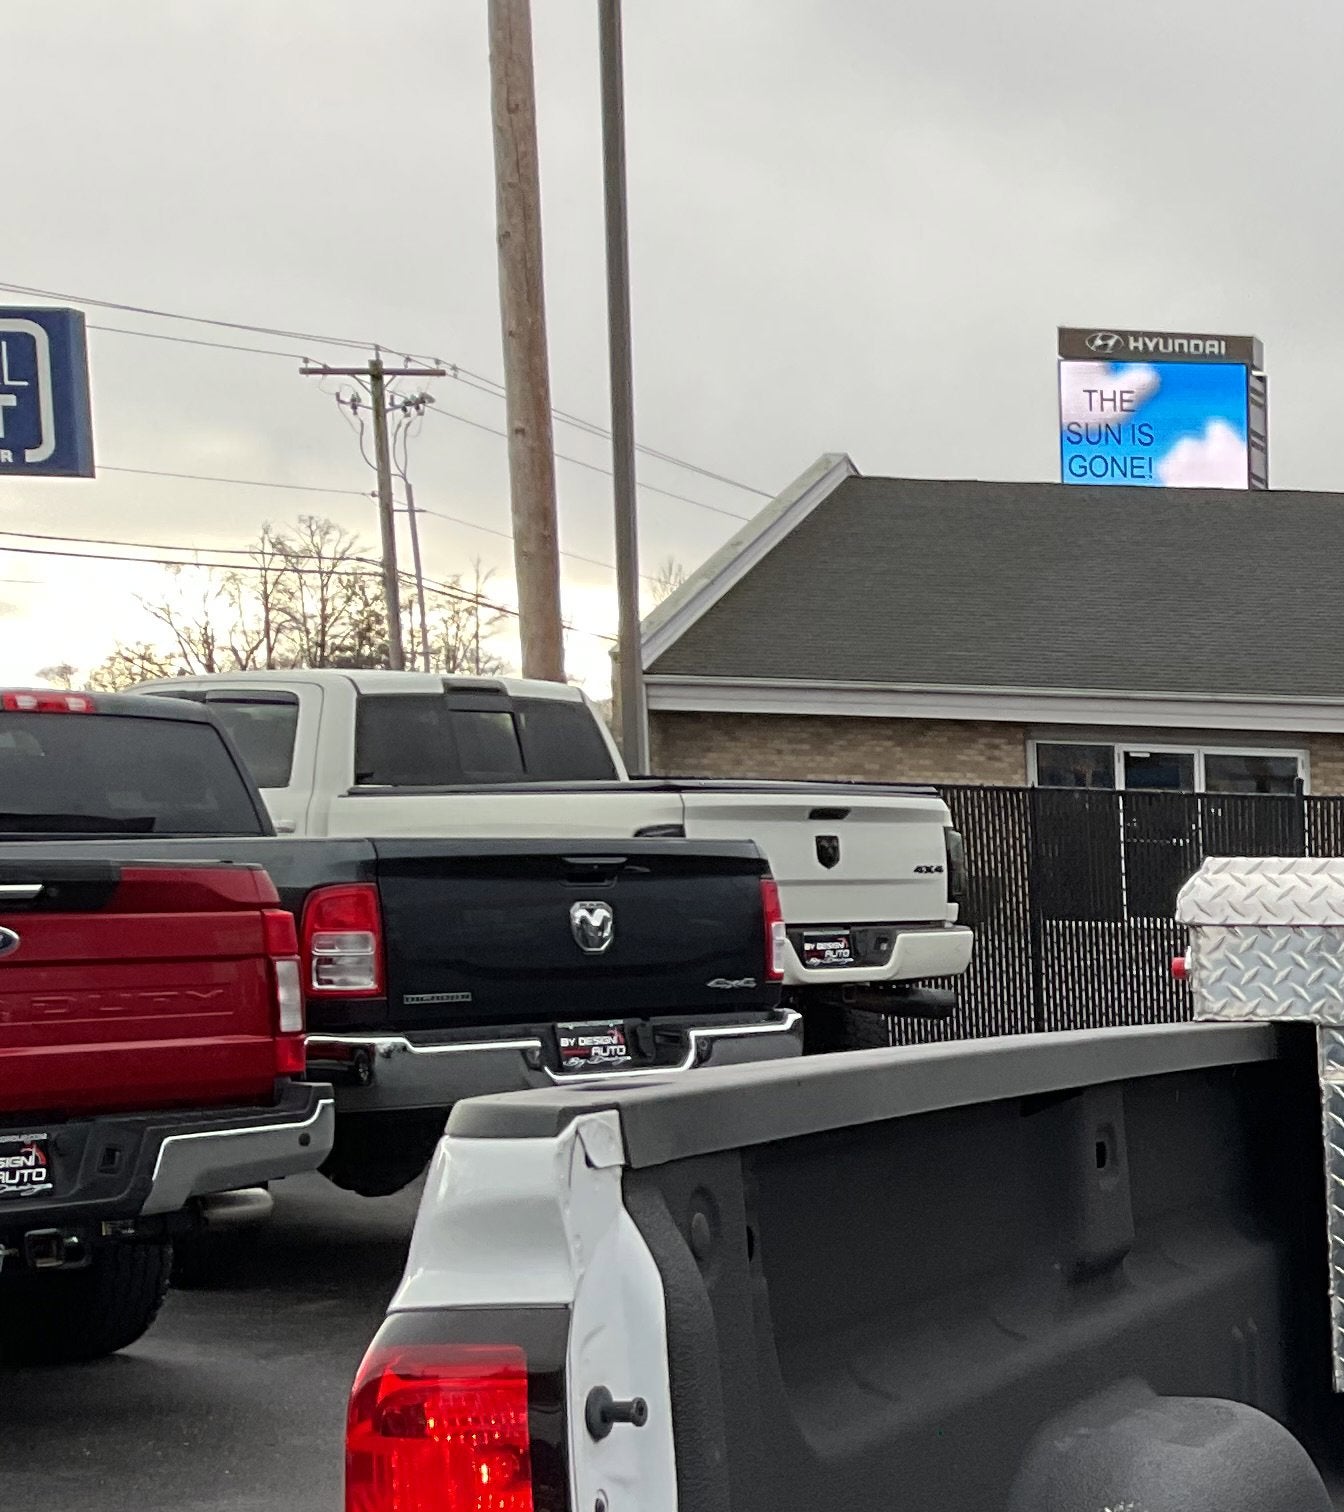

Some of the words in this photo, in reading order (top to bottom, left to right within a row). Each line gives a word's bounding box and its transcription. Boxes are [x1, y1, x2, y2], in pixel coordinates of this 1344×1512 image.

[1128, 335, 1226, 355] HYUNDAI
[1083, 389, 1136, 412] THE
[1066, 421, 1123, 446] SUN
[1131, 423, 1155, 447] IS
[1068, 454, 1153, 480] GONE!
[560, 1037, 576, 1047] BY
[578, 1034, 619, 1047] DESIGN
[591, 1045, 626, 1057] AUTO
